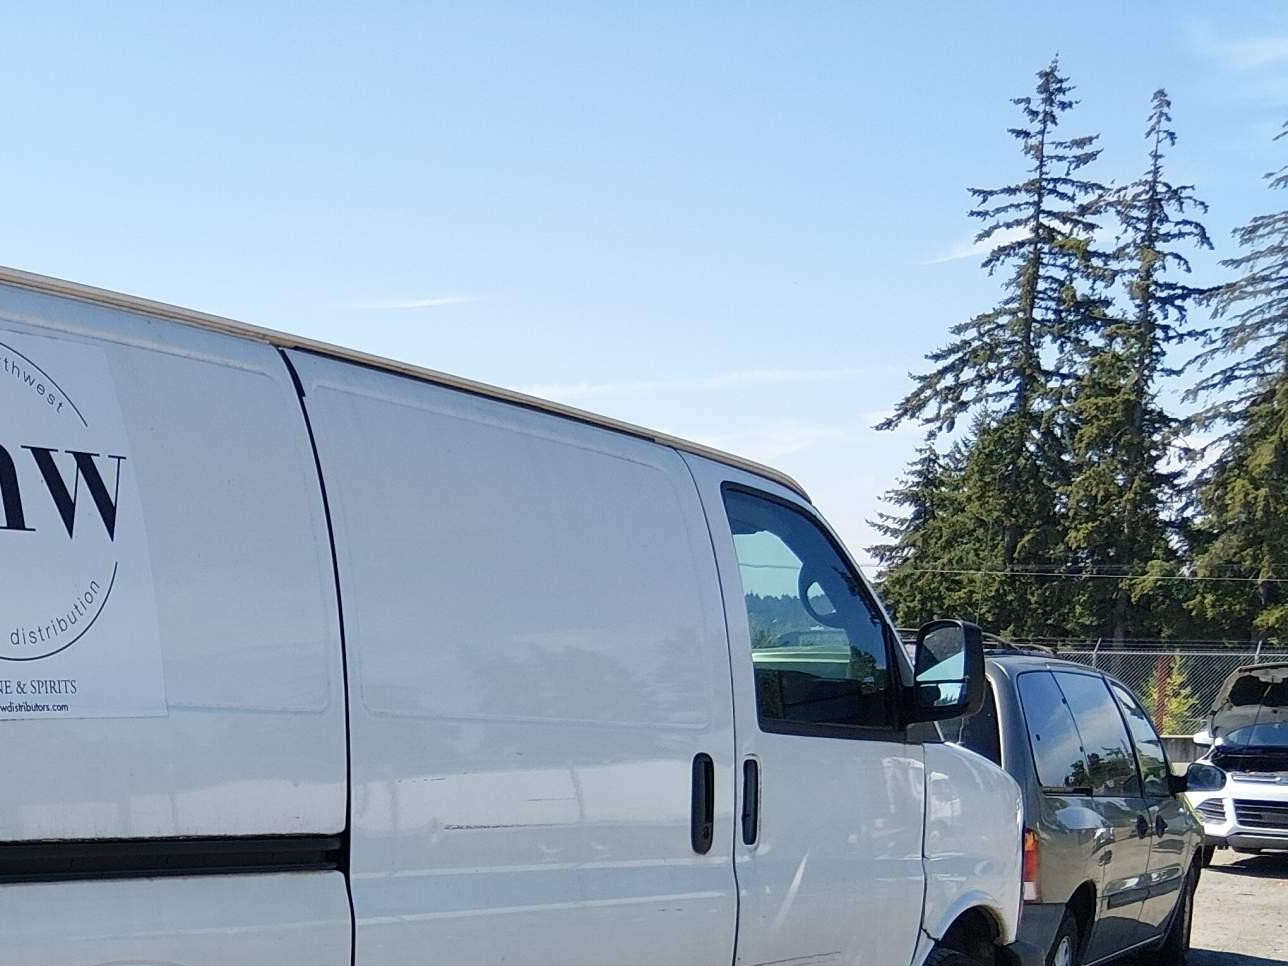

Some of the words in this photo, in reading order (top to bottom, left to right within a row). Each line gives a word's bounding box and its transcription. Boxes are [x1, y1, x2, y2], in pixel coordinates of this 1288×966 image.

[10, 580, 101, 645] distribution
[16, 680, 27, 695] &
[30, 679, 77, 695] SPIRITS
